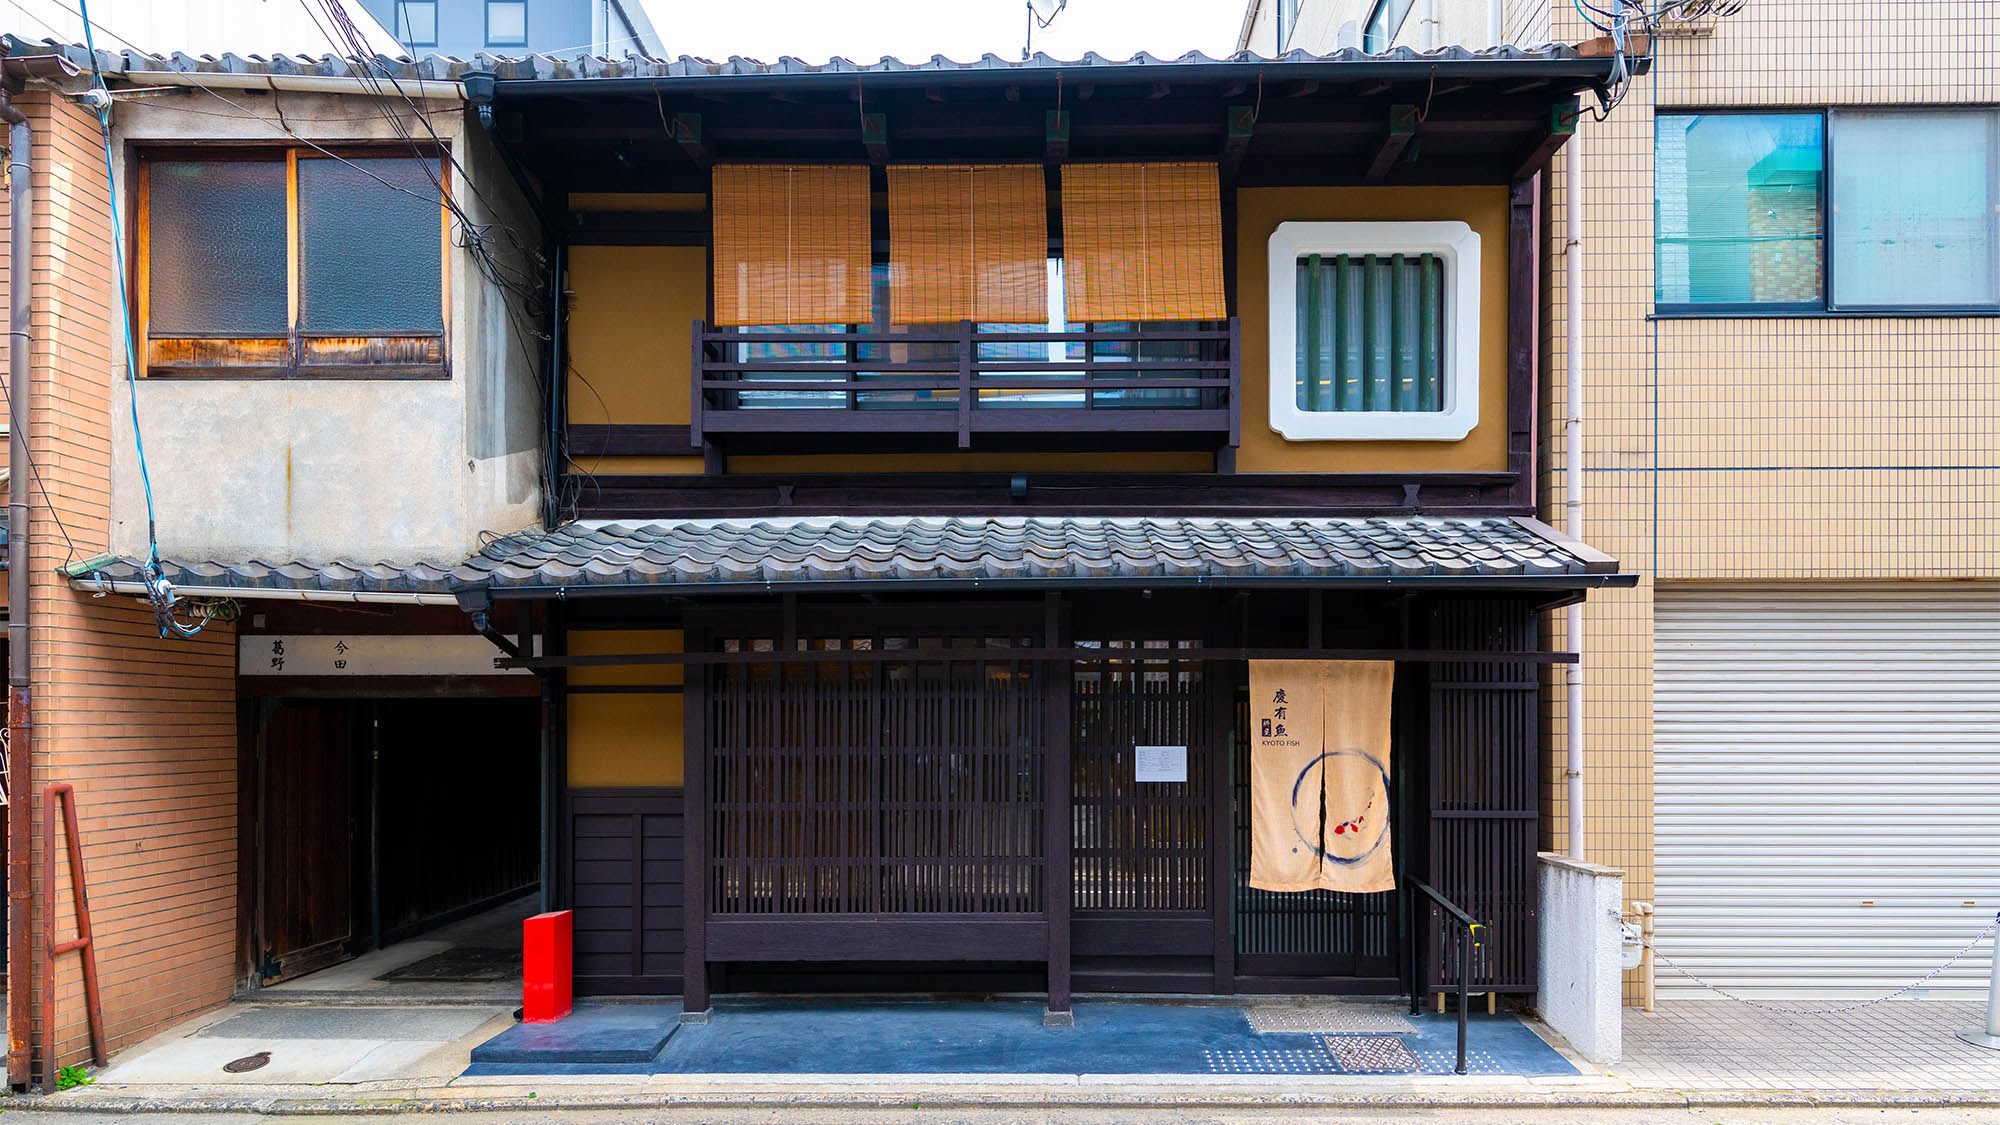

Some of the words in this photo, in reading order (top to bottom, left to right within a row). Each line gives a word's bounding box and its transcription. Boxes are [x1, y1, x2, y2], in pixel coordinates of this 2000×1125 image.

[270, 639, 285, 671] 葛野
[333, 640, 350, 669] 今田
[1272, 688, 1288, 737] 慶有魚
